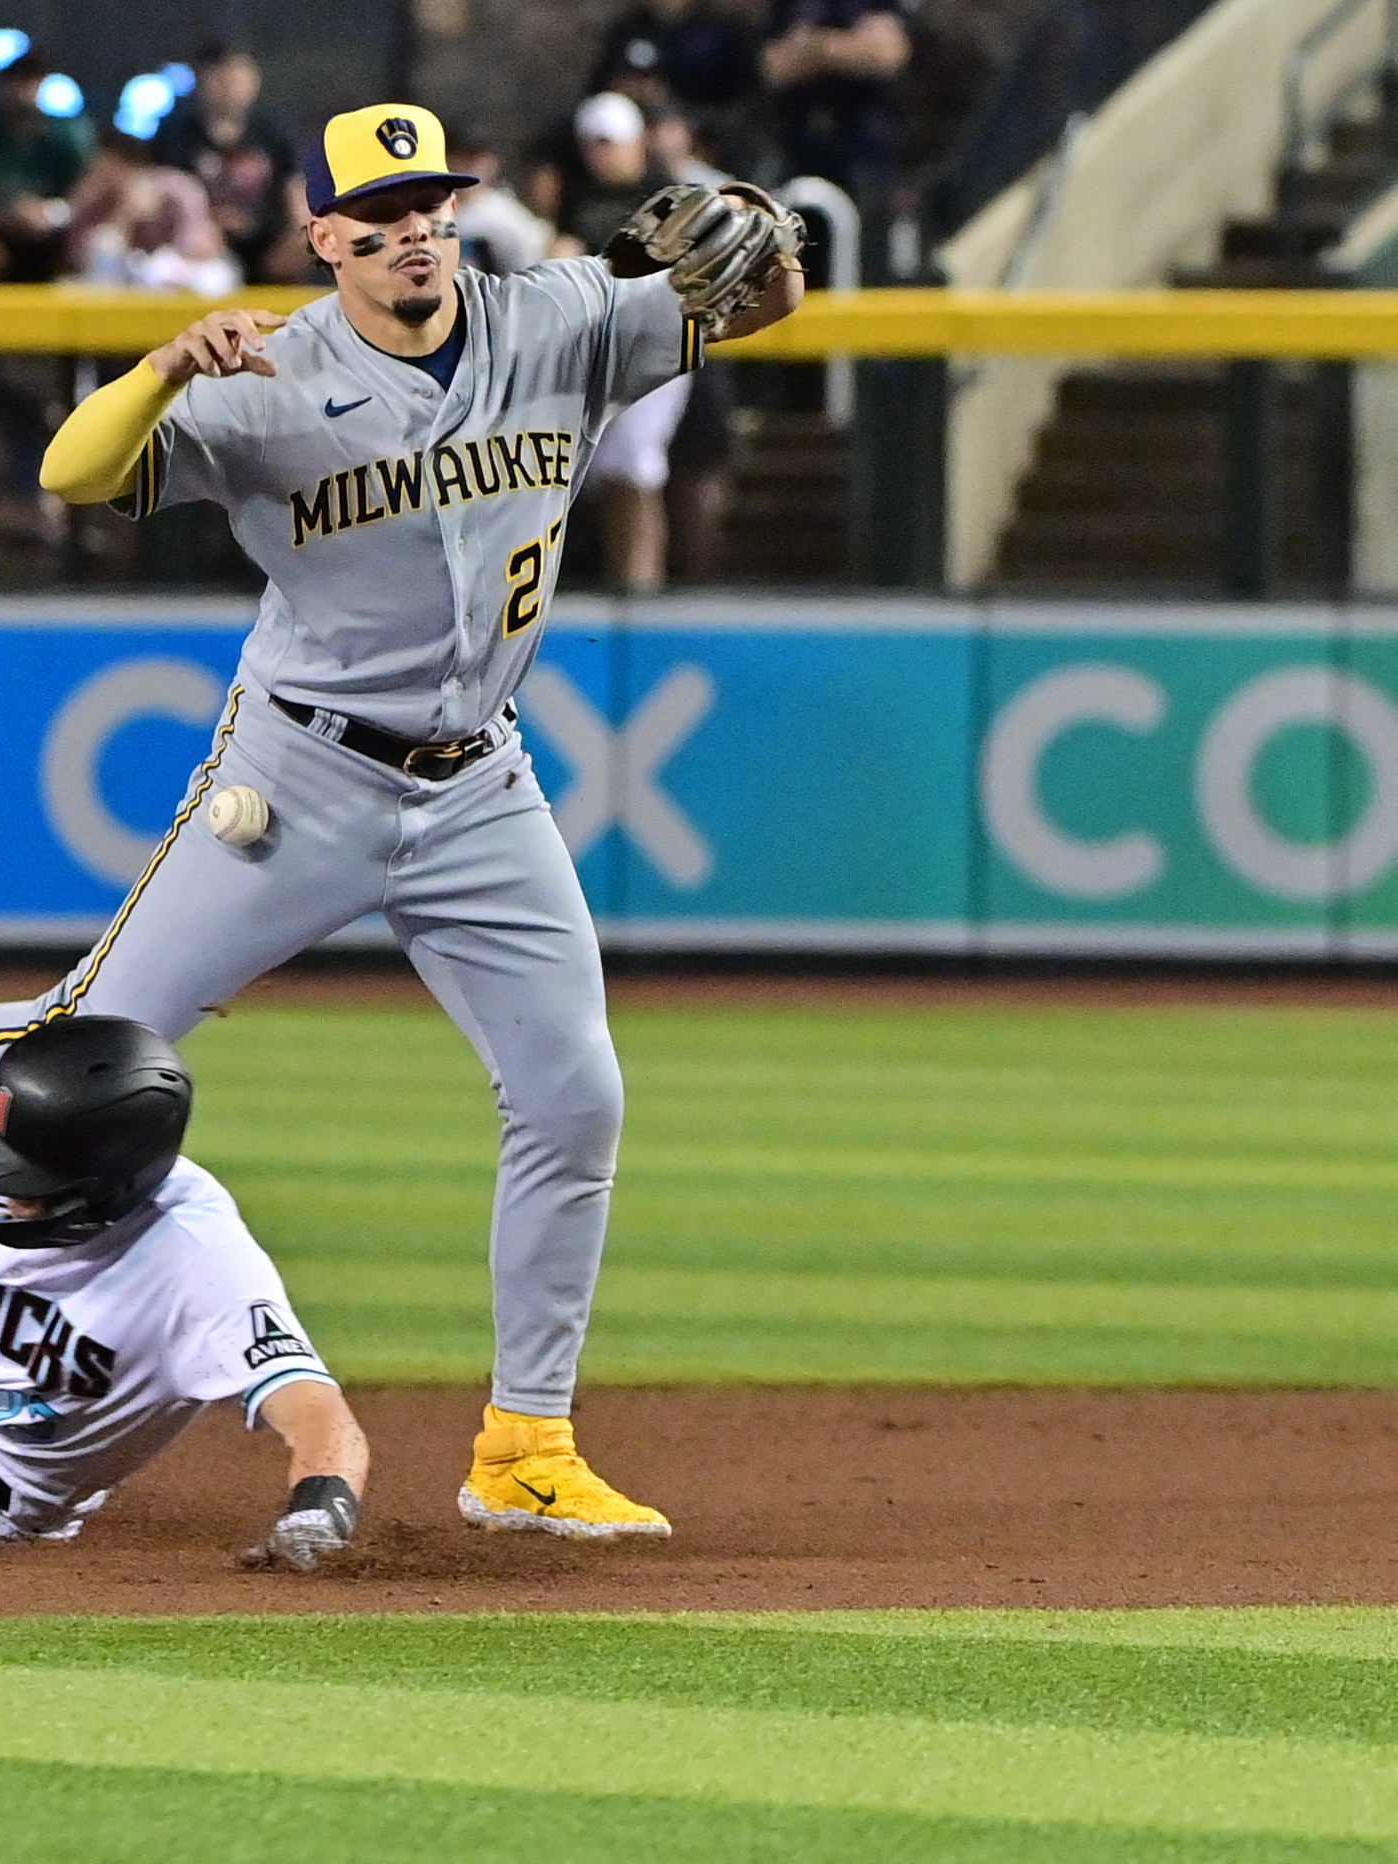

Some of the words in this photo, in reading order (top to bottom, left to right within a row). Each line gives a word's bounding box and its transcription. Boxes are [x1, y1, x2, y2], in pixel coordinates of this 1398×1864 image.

[288, 430, 573, 550] MILWAUKEE
[39, 656, 716, 888] CX
[978, 658, 1398, 901] CO
